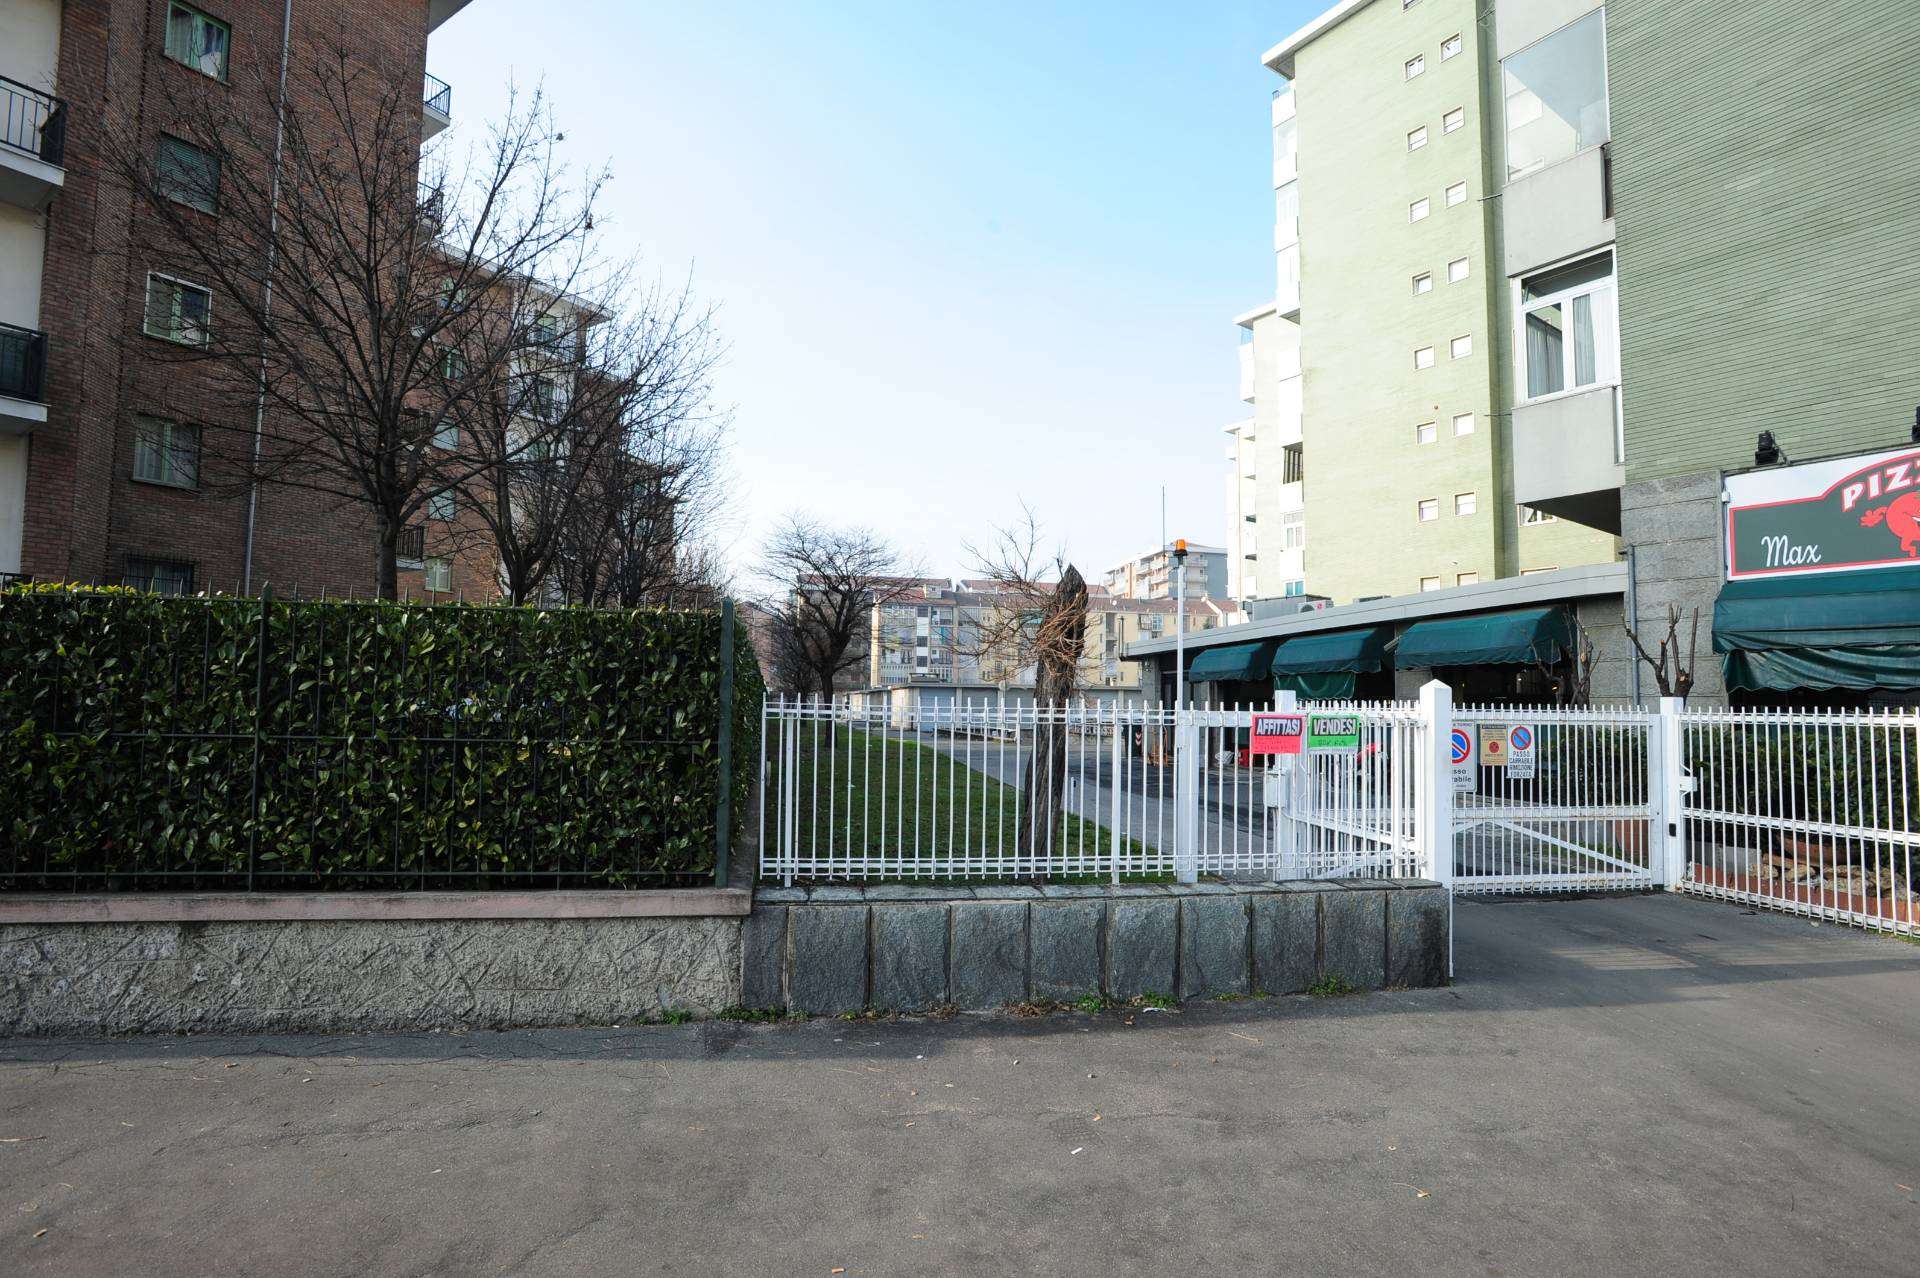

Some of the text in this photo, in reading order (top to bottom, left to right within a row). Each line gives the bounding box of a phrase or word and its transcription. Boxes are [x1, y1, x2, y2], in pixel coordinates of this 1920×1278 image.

[1761, 535, 1821, 567] Max
[1256, 718, 1301, 735] AFFITTASI
[1313, 718, 1356, 735] VENDESI
